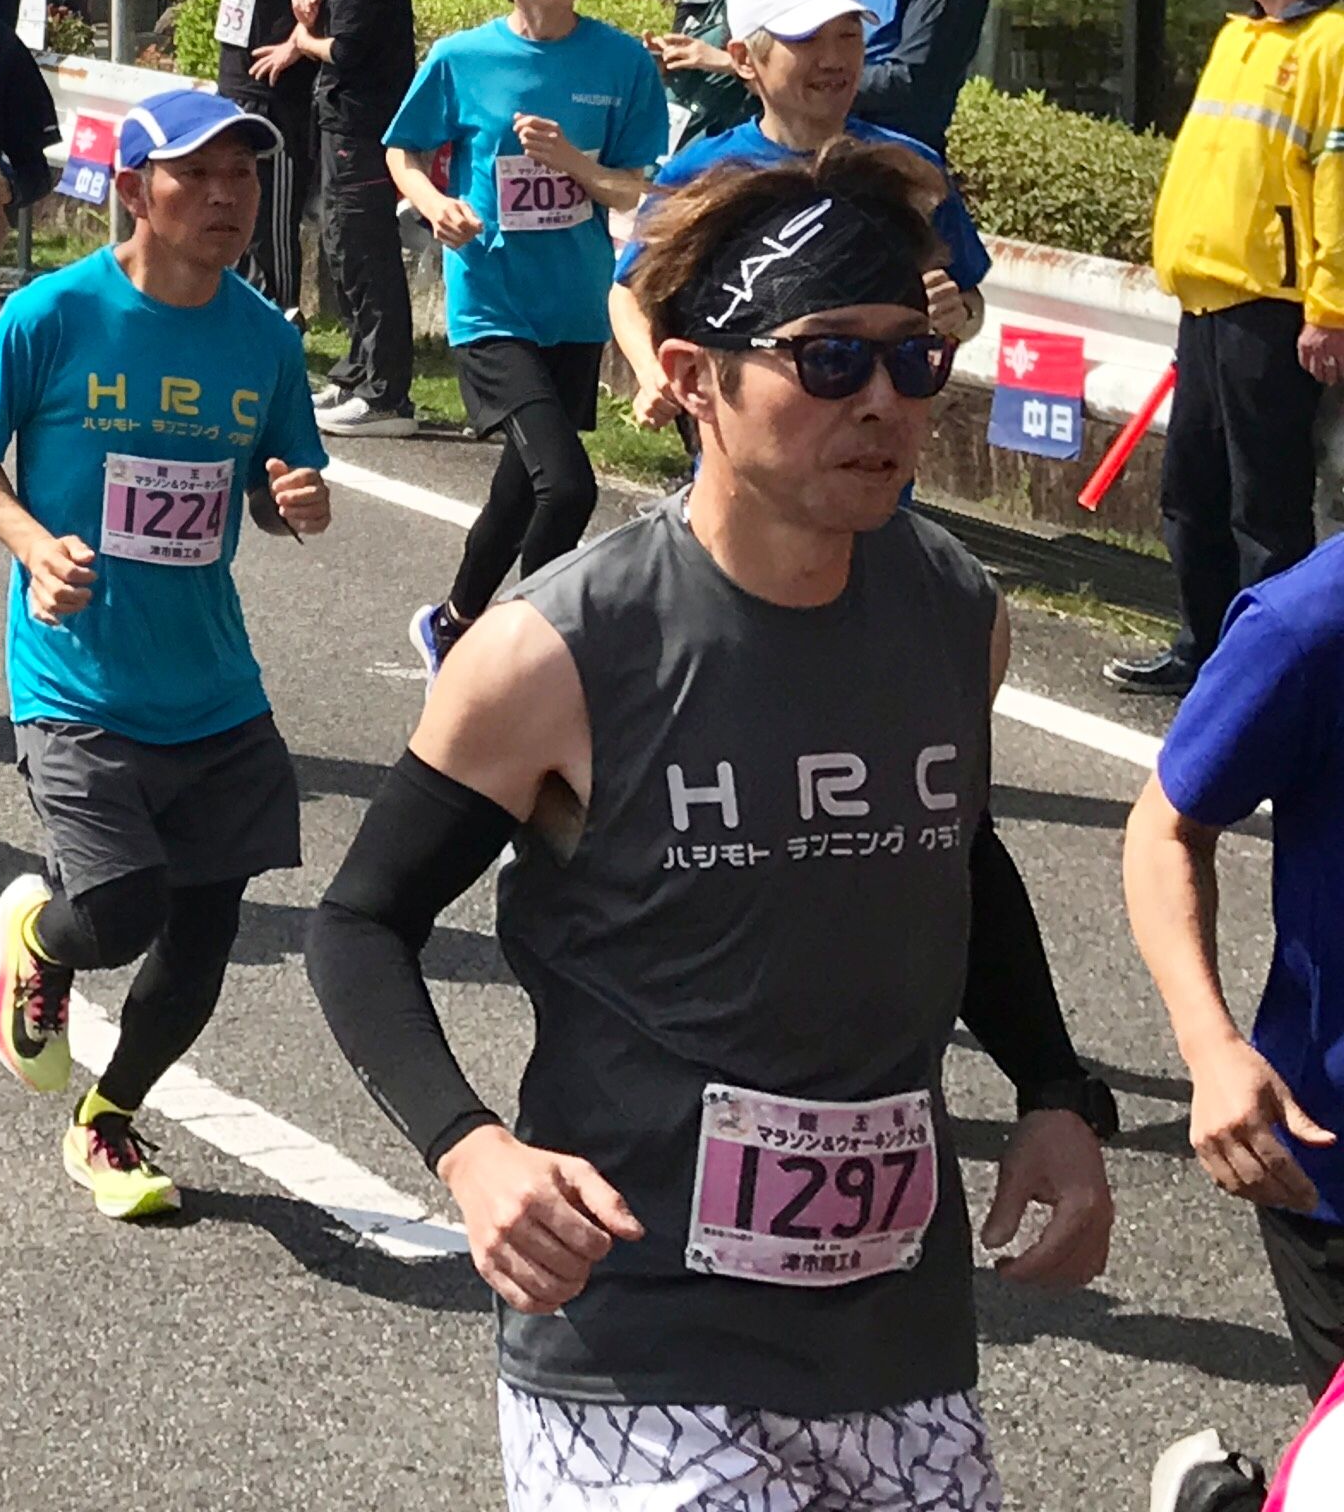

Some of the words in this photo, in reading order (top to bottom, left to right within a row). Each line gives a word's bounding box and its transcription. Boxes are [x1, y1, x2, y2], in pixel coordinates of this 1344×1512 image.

[1022, 399, 1073, 443] 中日
[124, 485, 223, 540] 1224
[662, 842, 771, 870] ハシモト
[787, 824, 905, 860] ランニング
[735, 1144, 918, 1240] 1297
